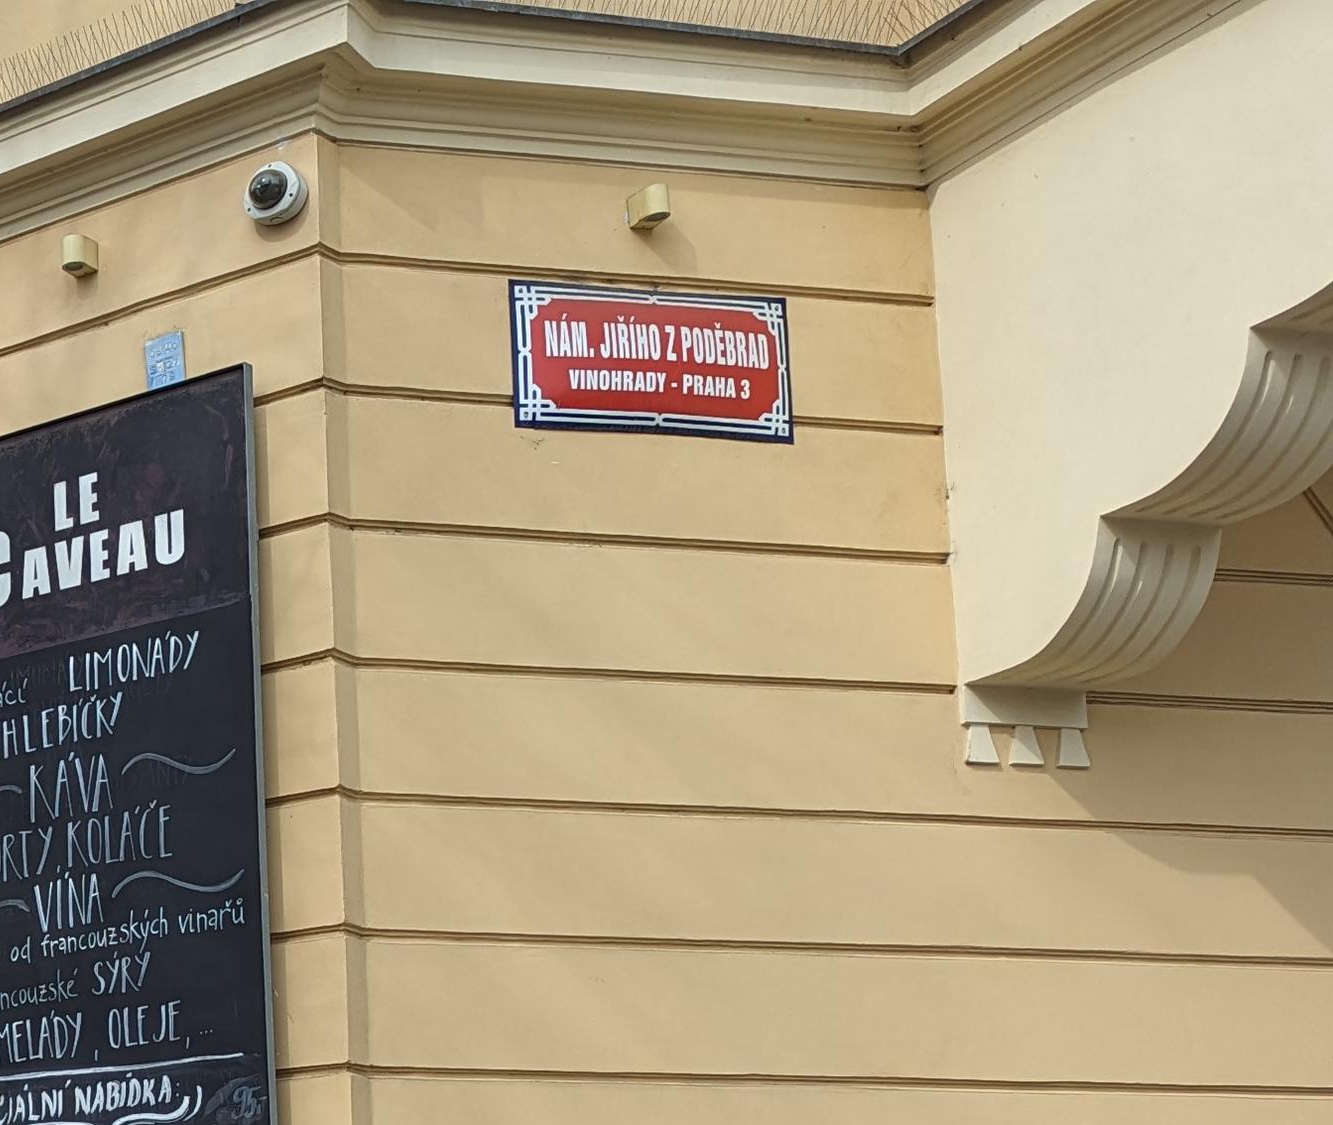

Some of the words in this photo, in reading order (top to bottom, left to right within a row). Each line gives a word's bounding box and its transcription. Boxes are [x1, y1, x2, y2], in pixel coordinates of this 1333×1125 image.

[544, 313, 594, 358] NÁM.
[600, 315, 661, 361] JIŘÍHO
[665, 327, 677, 362] Z
[681, 323, 770, 369] PODĚBRAD
[568, 368, 667, 393] VINOHRADY
[682, 375, 737, 399] PRAHA
[740, 379, 751, 400] 3
[53, 471, 100, 532] LE
[68, 630, 200, 692] LIMONÁDY
[29, 751, 114, 823] KÁVA
[66, 800, 173, 869] KOLÁČE
[9, 940, 32, 964] od
[40, 905, 169, 958] francouzských
[178, 897, 246, 934] vinařů
[34, 870, 104, 933] VÍNA
[91, 951, 151, 996] SÝRY
